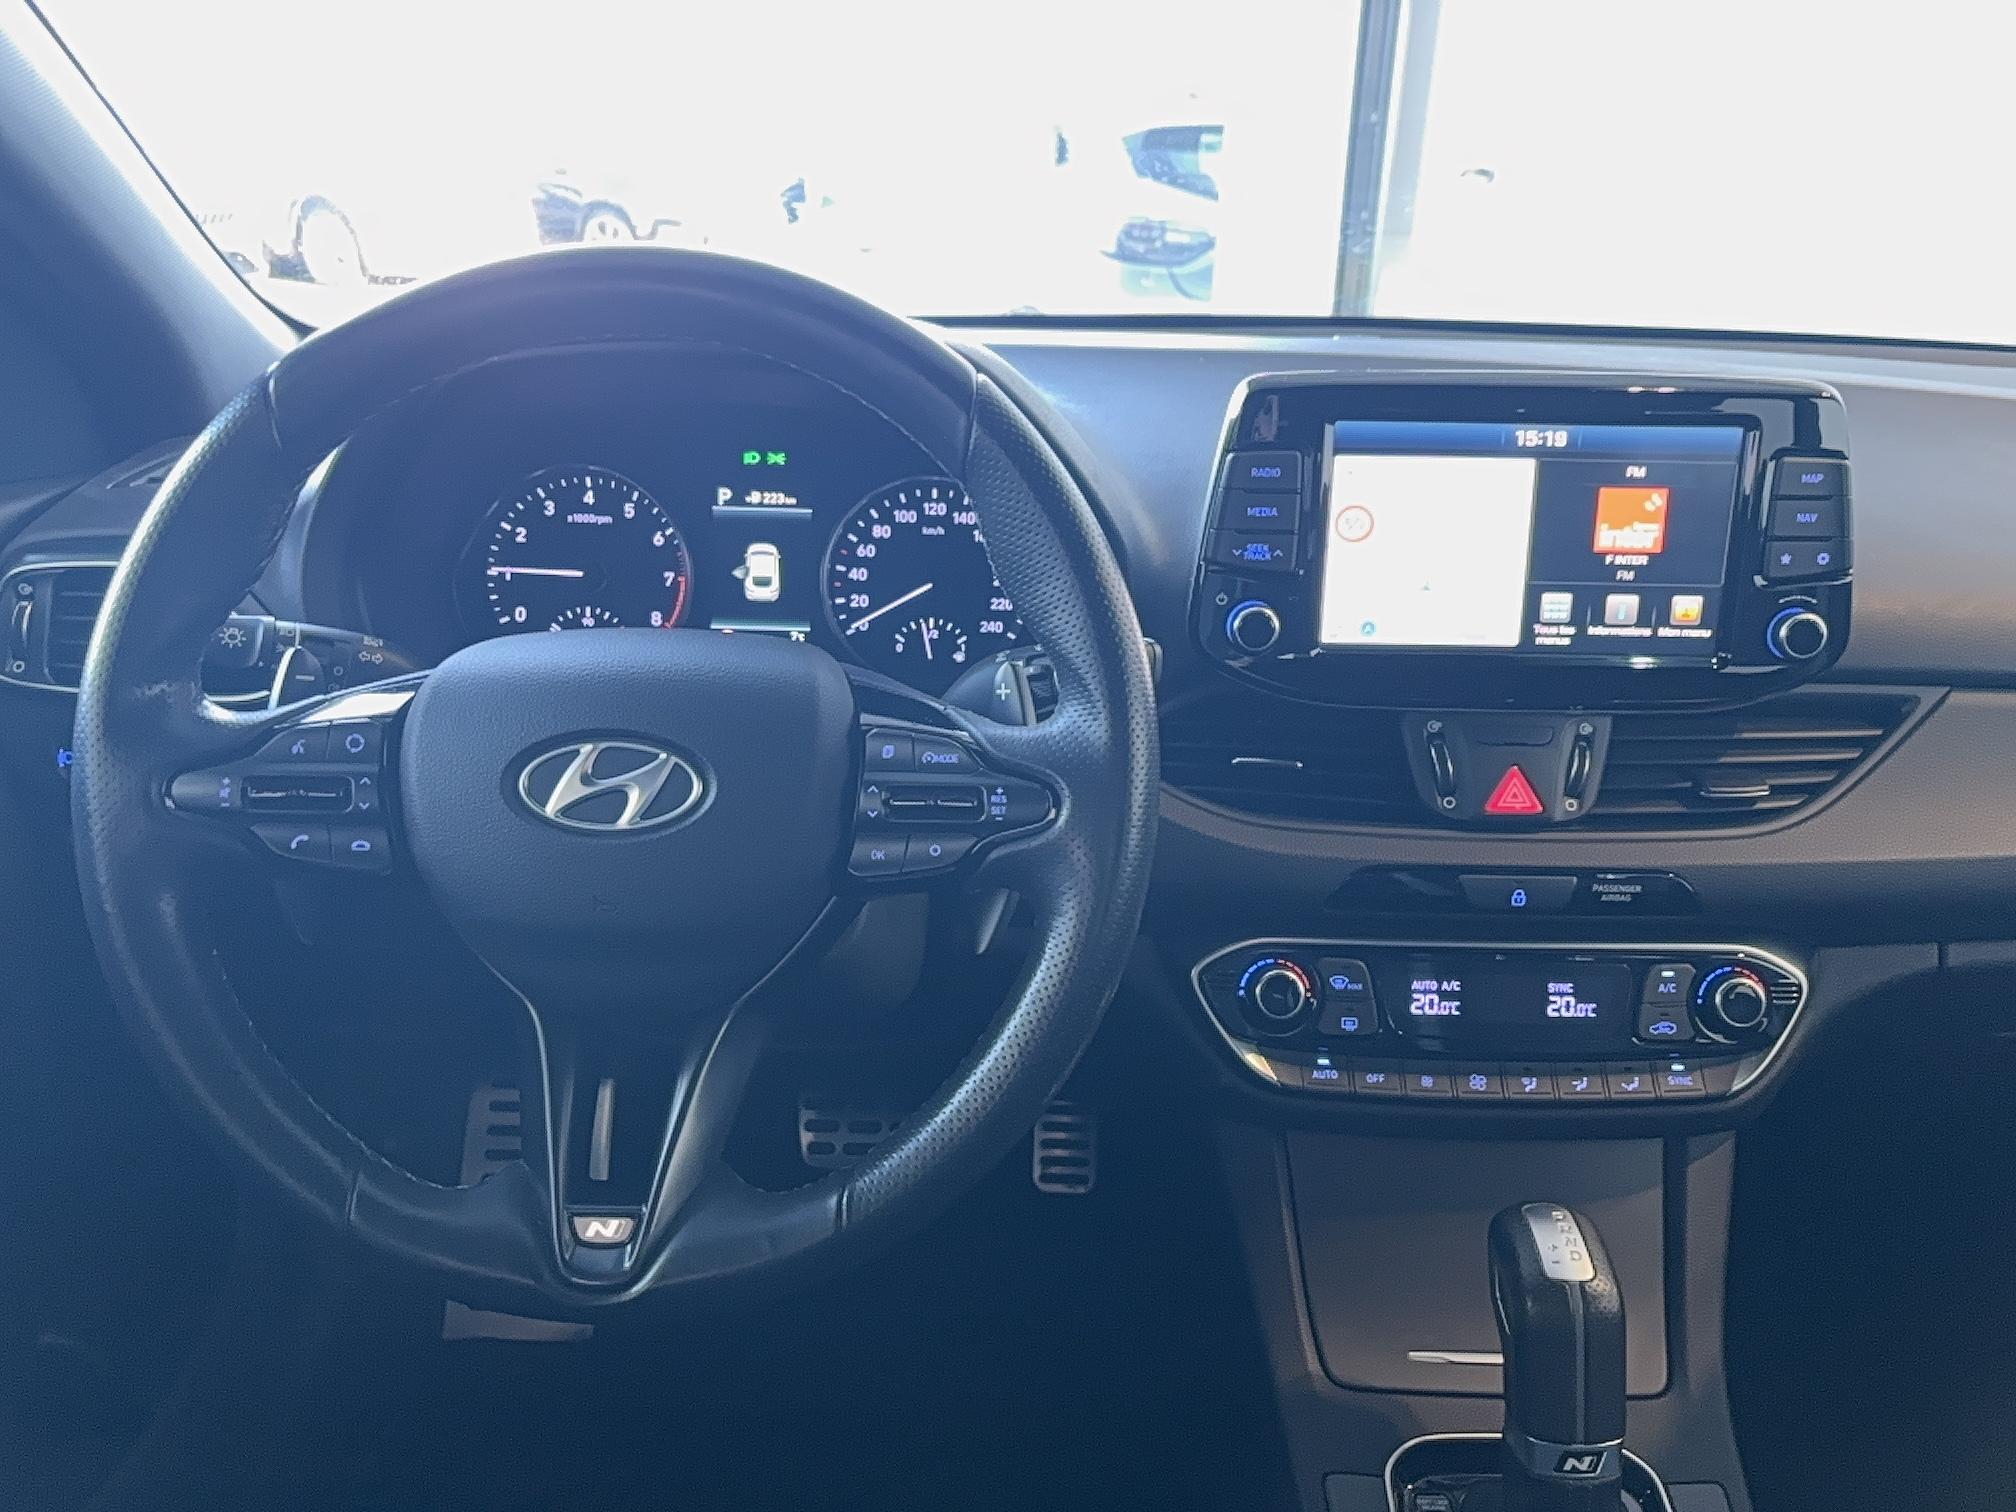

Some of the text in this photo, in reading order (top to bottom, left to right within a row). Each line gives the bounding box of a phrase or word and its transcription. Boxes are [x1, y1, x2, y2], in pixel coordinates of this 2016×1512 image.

[1515, 430, 1568, 447] 15:19
[1251, 467, 1281, 477] RADIO
[1625, 465, 1647, 478] FM
[1801, 473, 1824, 484] MAP
[583, 489, 596, 505] 4
[717, 486, 733, 506] P
[762, 491, 785, 505] 223
[543, 500, 556, 516] 3
[623, 502, 636, 519] 5
[922, 502, 948, 516] 120
[1247, 507, 1277, 517] MEDIA
[893, 510, 917, 524] 100
[952, 512, 976, 526] 140
[1797, 512, 1818, 523] NAV
[514, 527, 528, 543] 2
[871, 525, 892, 540] 80
[921, 526, 945, 536] km/h
[653, 530, 665, 547] 6
[856, 544, 876, 558] 60
[663, 571, 675, 587] 7
[848, 568, 868, 582] 40
[1616, 571, 1635, 582] FM
[850, 594, 870, 608] 20
[990, 597, 1013, 611] 220
[514, 606, 527, 623] 0
[650, 611, 663, 627] 8
[979, 620, 1003, 634] 240
[895, 643, 904, 653] 0
[871, 850, 885, 860] OK
[1592, 884, 1642, 893] PASSENGER
[1600, 894, 1632, 902] AIRBAG
[1411, 980, 1461, 991] AUTO A/C
[1547, 983, 1574, 993] SYNC
[1658, 983, 1677, 993] A/C
[1312, 1070, 1338, 1079] AUTO
[1366, 1073, 1385, 1083] OFF
[1667, 1075, 1693, 1086] SYNC
[1569, 1250, 1583, 1262] D
